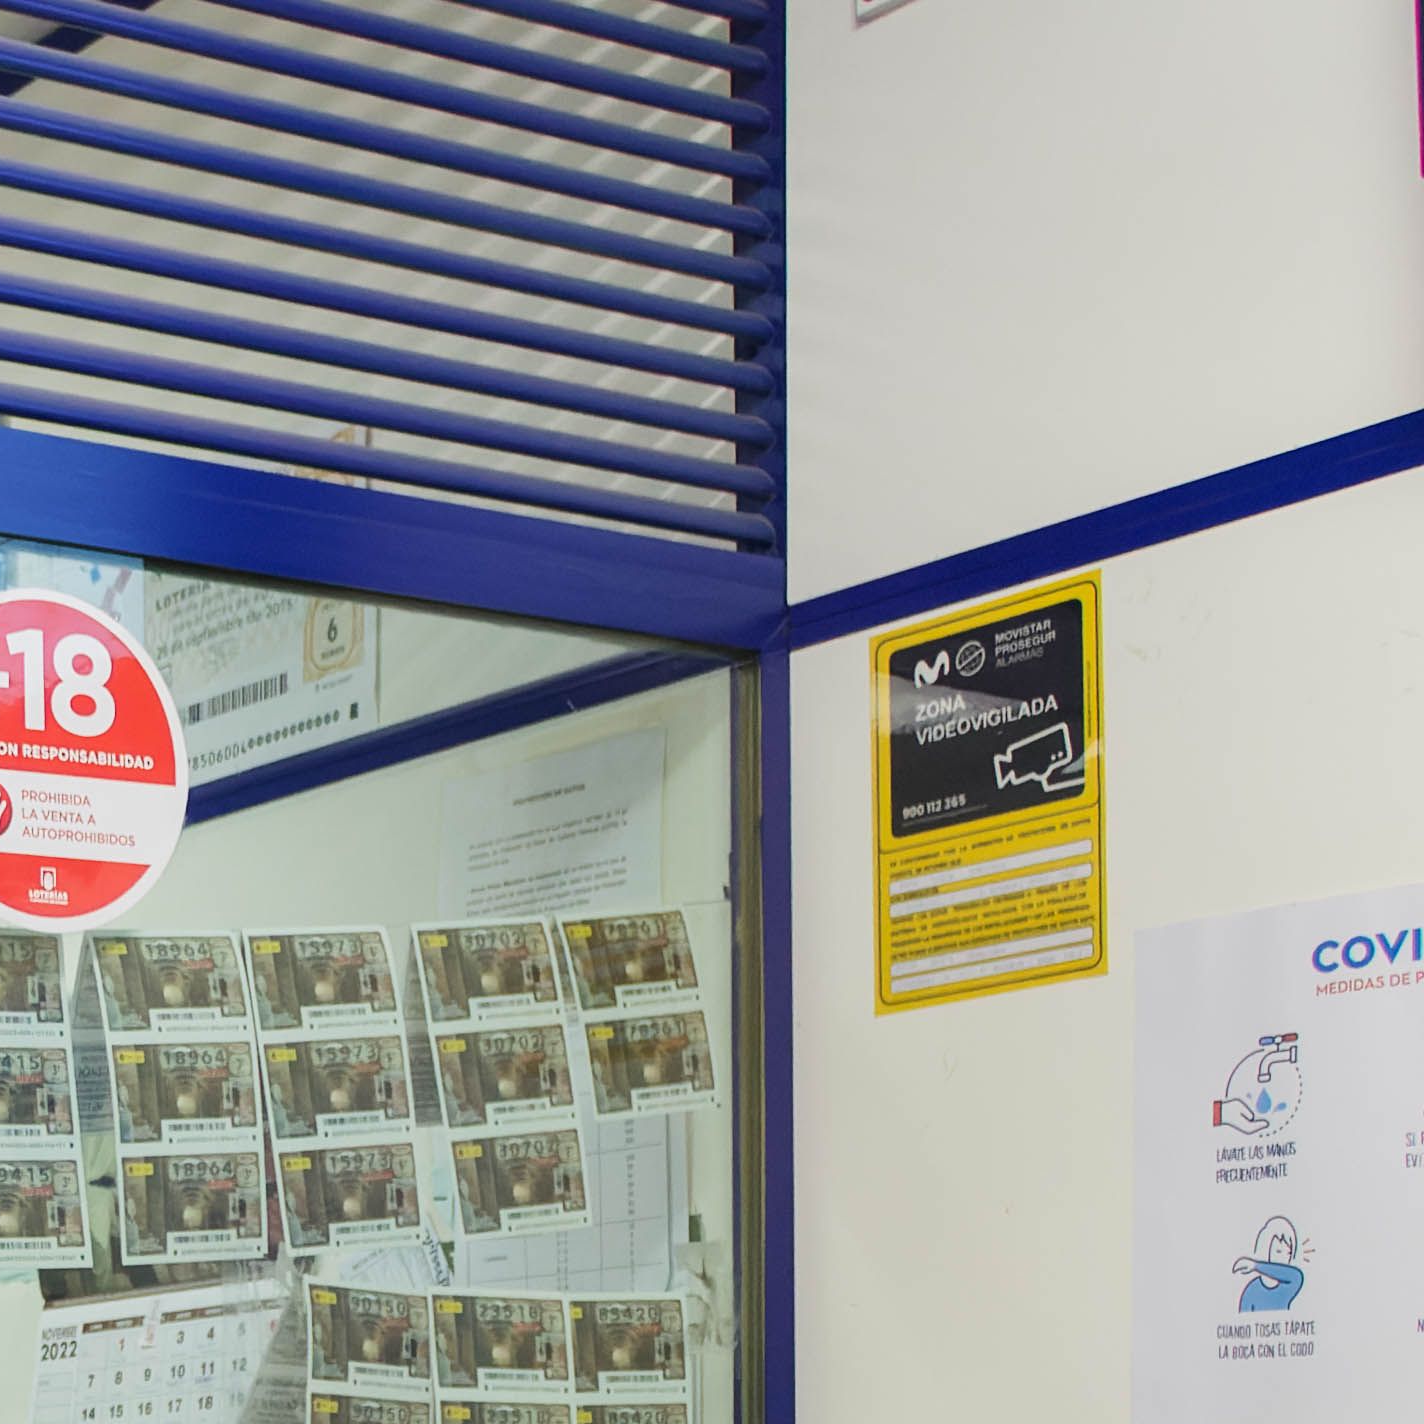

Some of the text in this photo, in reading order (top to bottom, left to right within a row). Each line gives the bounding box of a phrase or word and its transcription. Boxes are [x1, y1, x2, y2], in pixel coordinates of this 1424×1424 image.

[995, 619, 1051, 644] MOVISTAR
[995, 630, 1057, 656] PROSEGUR
[915, 694, 966, 722] ZONA
[916, 694, 1058, 746] VIDEOVIGILADA
[23, 743, 154, 770] RESPONSABILIDAD
[21, 789, 91, 806] PROHIBIDA
[21, 807, 96, 825] LA VENTA A
[22, 826, 136, 847] AUTOPROHIBIDOS
[1315, 972, 1411, 997] MEDIDAS DE
[1217, 1323, 1251, 1339] CUANDO
[1254, 1322, 1281, 1338] TOSAS
[41, 1340, 77, 1362] 2022
[1218, 1342, 1314, 1360] LA BOCA CON EL CODO
